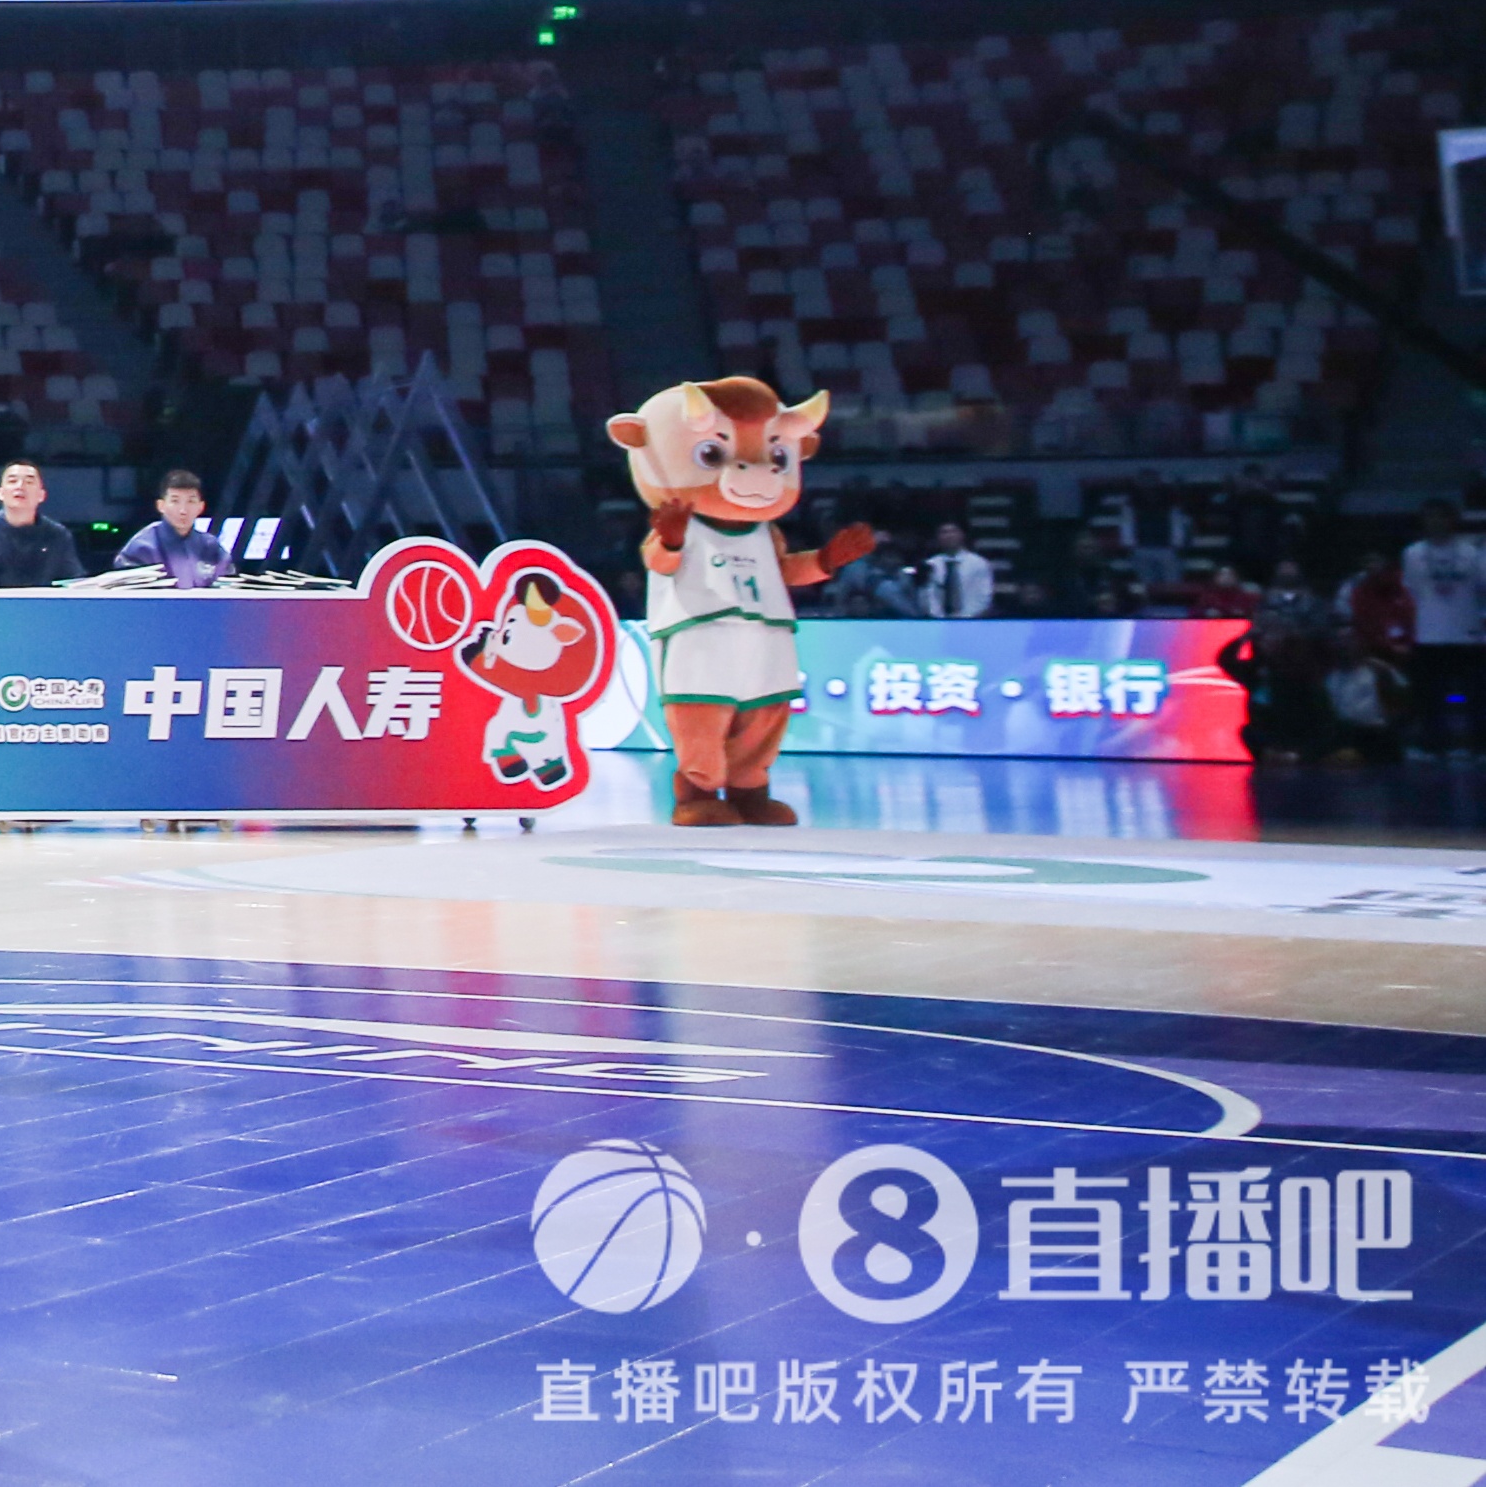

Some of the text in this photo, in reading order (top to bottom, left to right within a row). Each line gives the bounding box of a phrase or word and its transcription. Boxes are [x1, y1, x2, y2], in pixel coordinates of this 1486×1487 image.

[33, 682, 101, 695] 中国人寿
[34, 697, 101, 706] CHINA LIFE
[123, 665, 444, 741] 中国人寿
[869, 661, 981, 716] 投资
[1046, 662, 1165, 720] 银行
